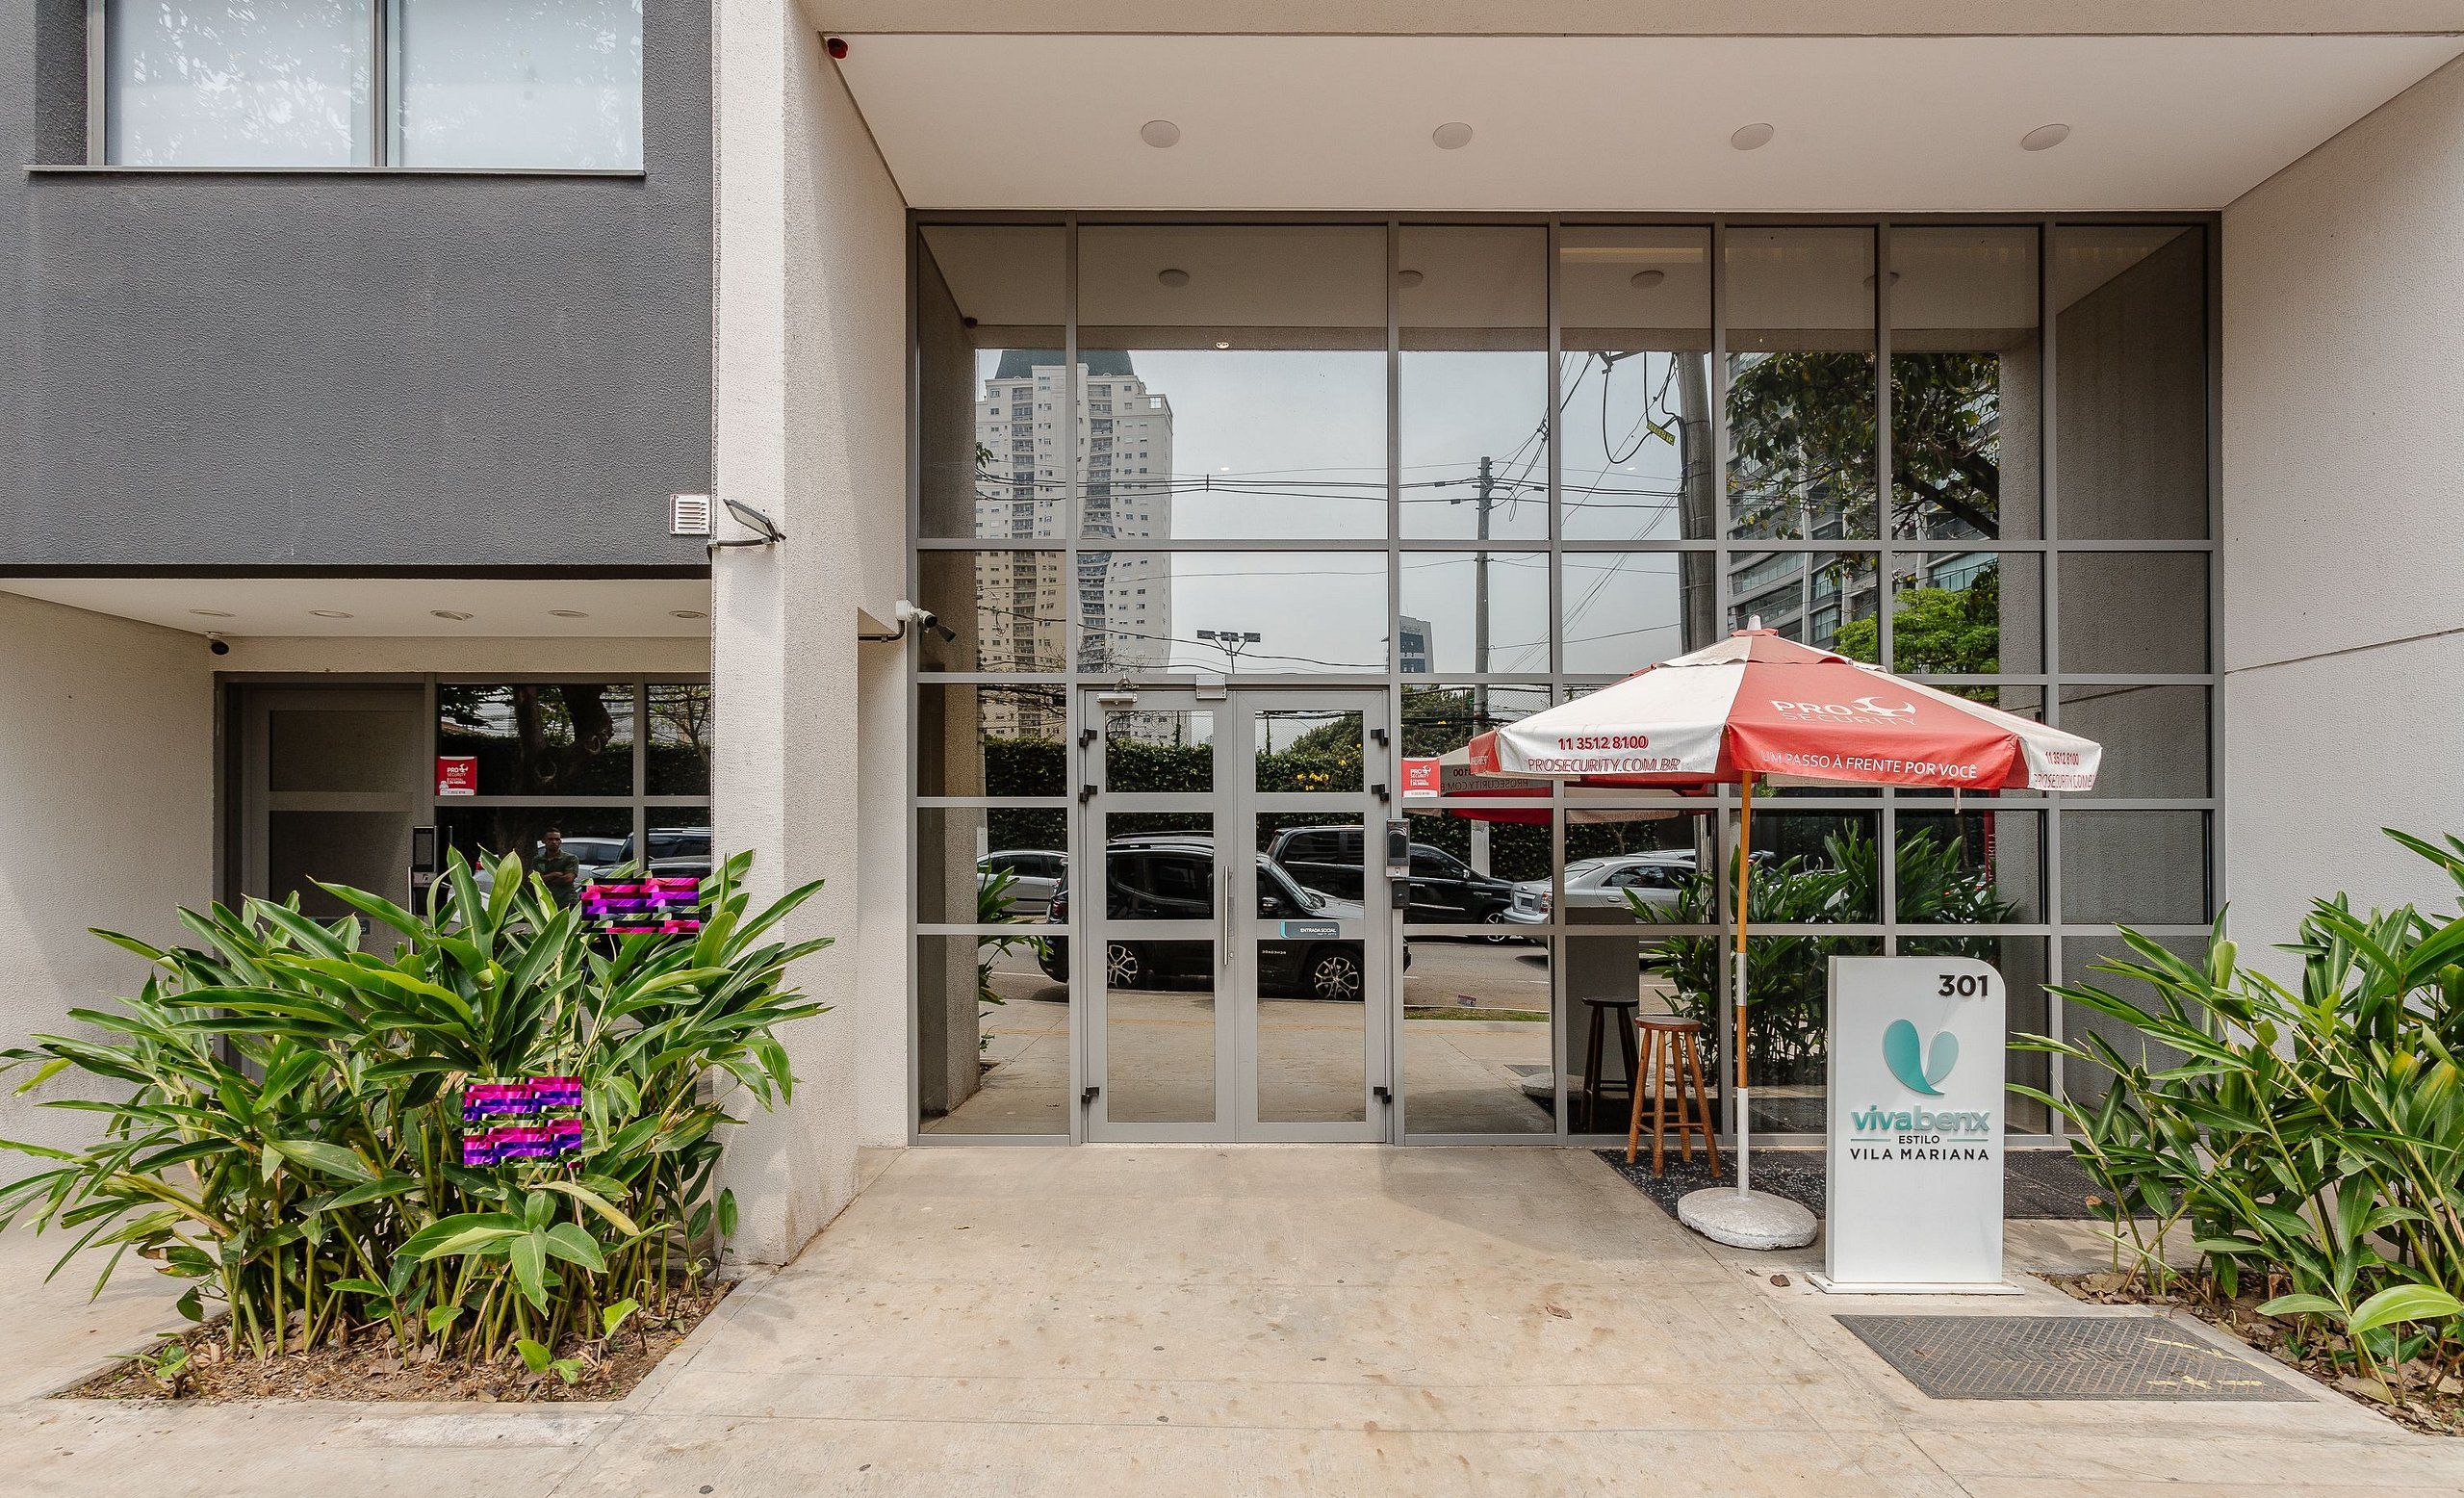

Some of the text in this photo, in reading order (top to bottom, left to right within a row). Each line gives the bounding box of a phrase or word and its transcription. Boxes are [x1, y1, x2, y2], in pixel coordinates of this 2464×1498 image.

[1771, 700, 1854, 715] PRO
[1782, 712, 1917, 725] SECURITY
[1558, 735, 1649, 750] 11 3512 8100
[1527, 758, 1681, 772] PROSECURITY.COM.BR
[1760, 750, 1978, 779] UM PASSO À FRENTE POR VOCÊ
[1938, 974, 1989, 997] 301
[1850, 1105, 1991, 1132] vivabenx
[1898, 1135, 1940, 1145] ESTILO
[1850, 1149, 1989, 1161] VILA MARIANA
